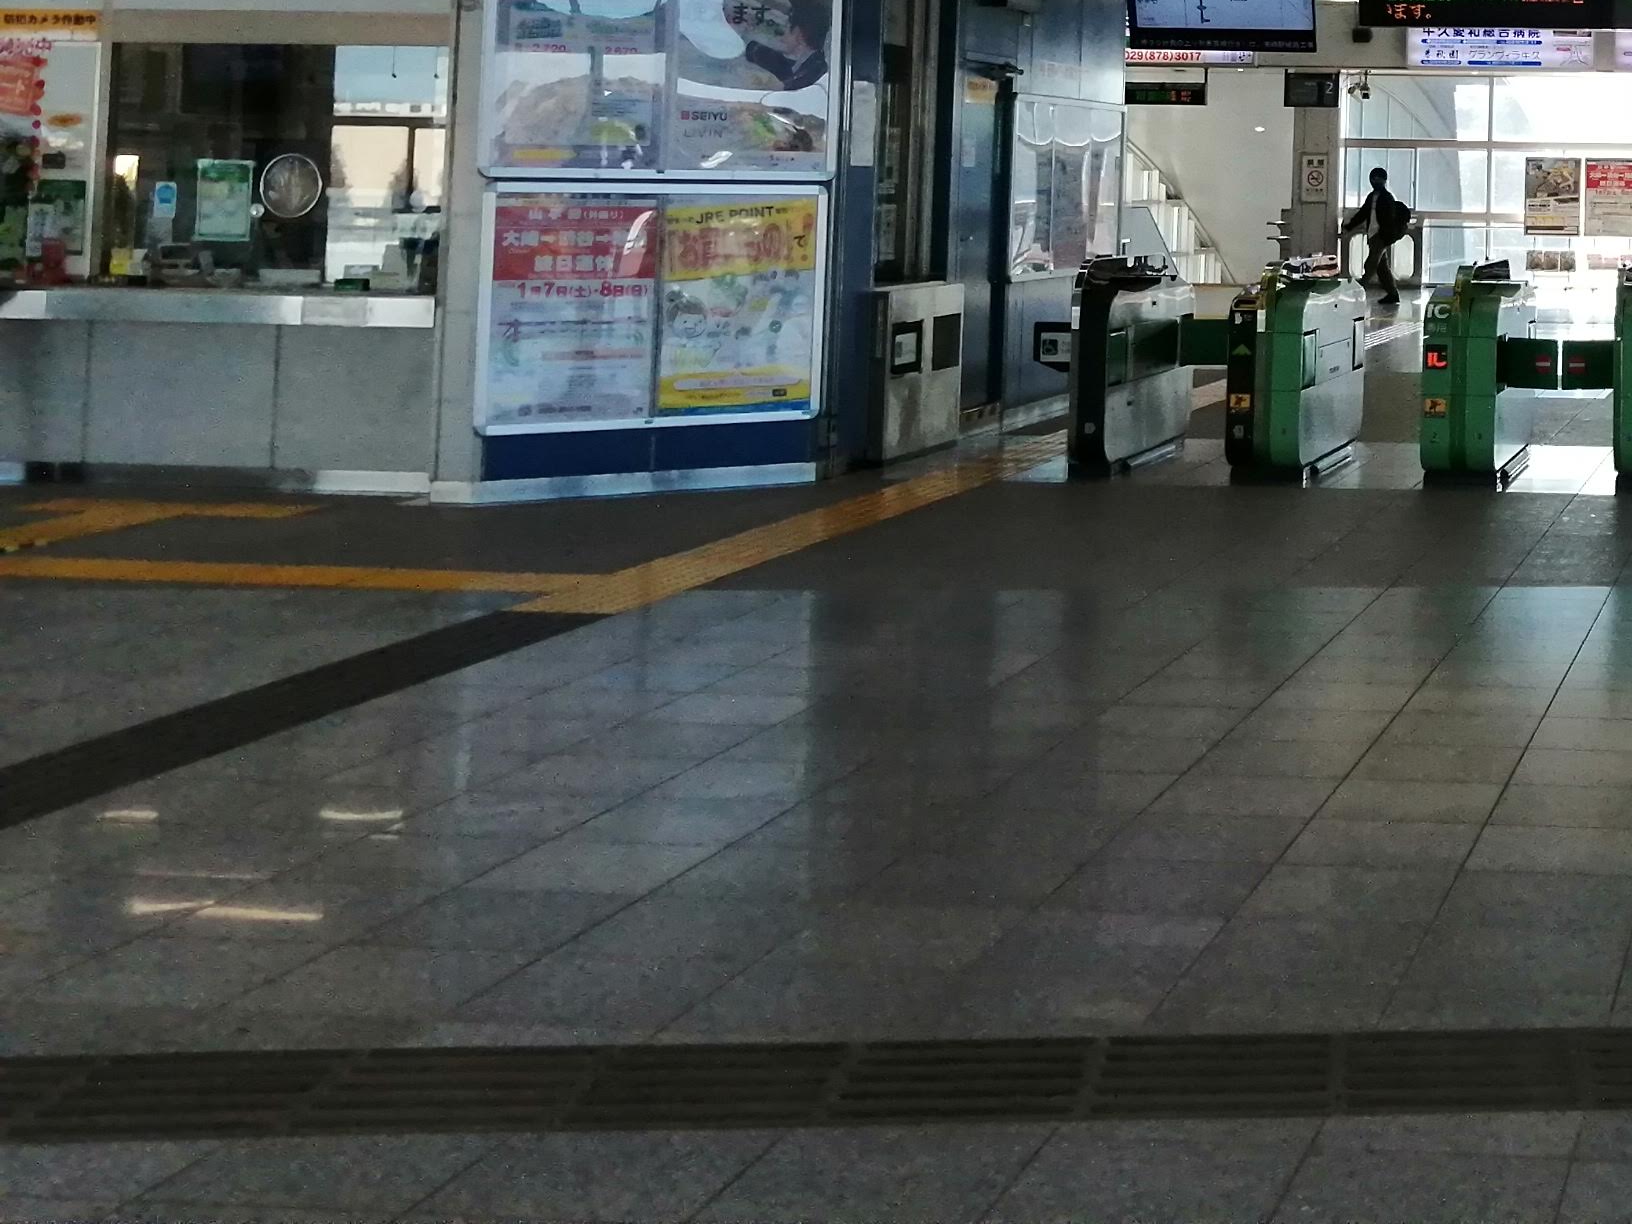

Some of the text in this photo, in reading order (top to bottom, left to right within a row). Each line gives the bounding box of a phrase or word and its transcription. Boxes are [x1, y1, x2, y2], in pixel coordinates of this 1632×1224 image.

[1325, 81, 1334, 94] 2
[690, 110, 728, 122] SEIYU
[1427, 303, 1451, 319] IC
